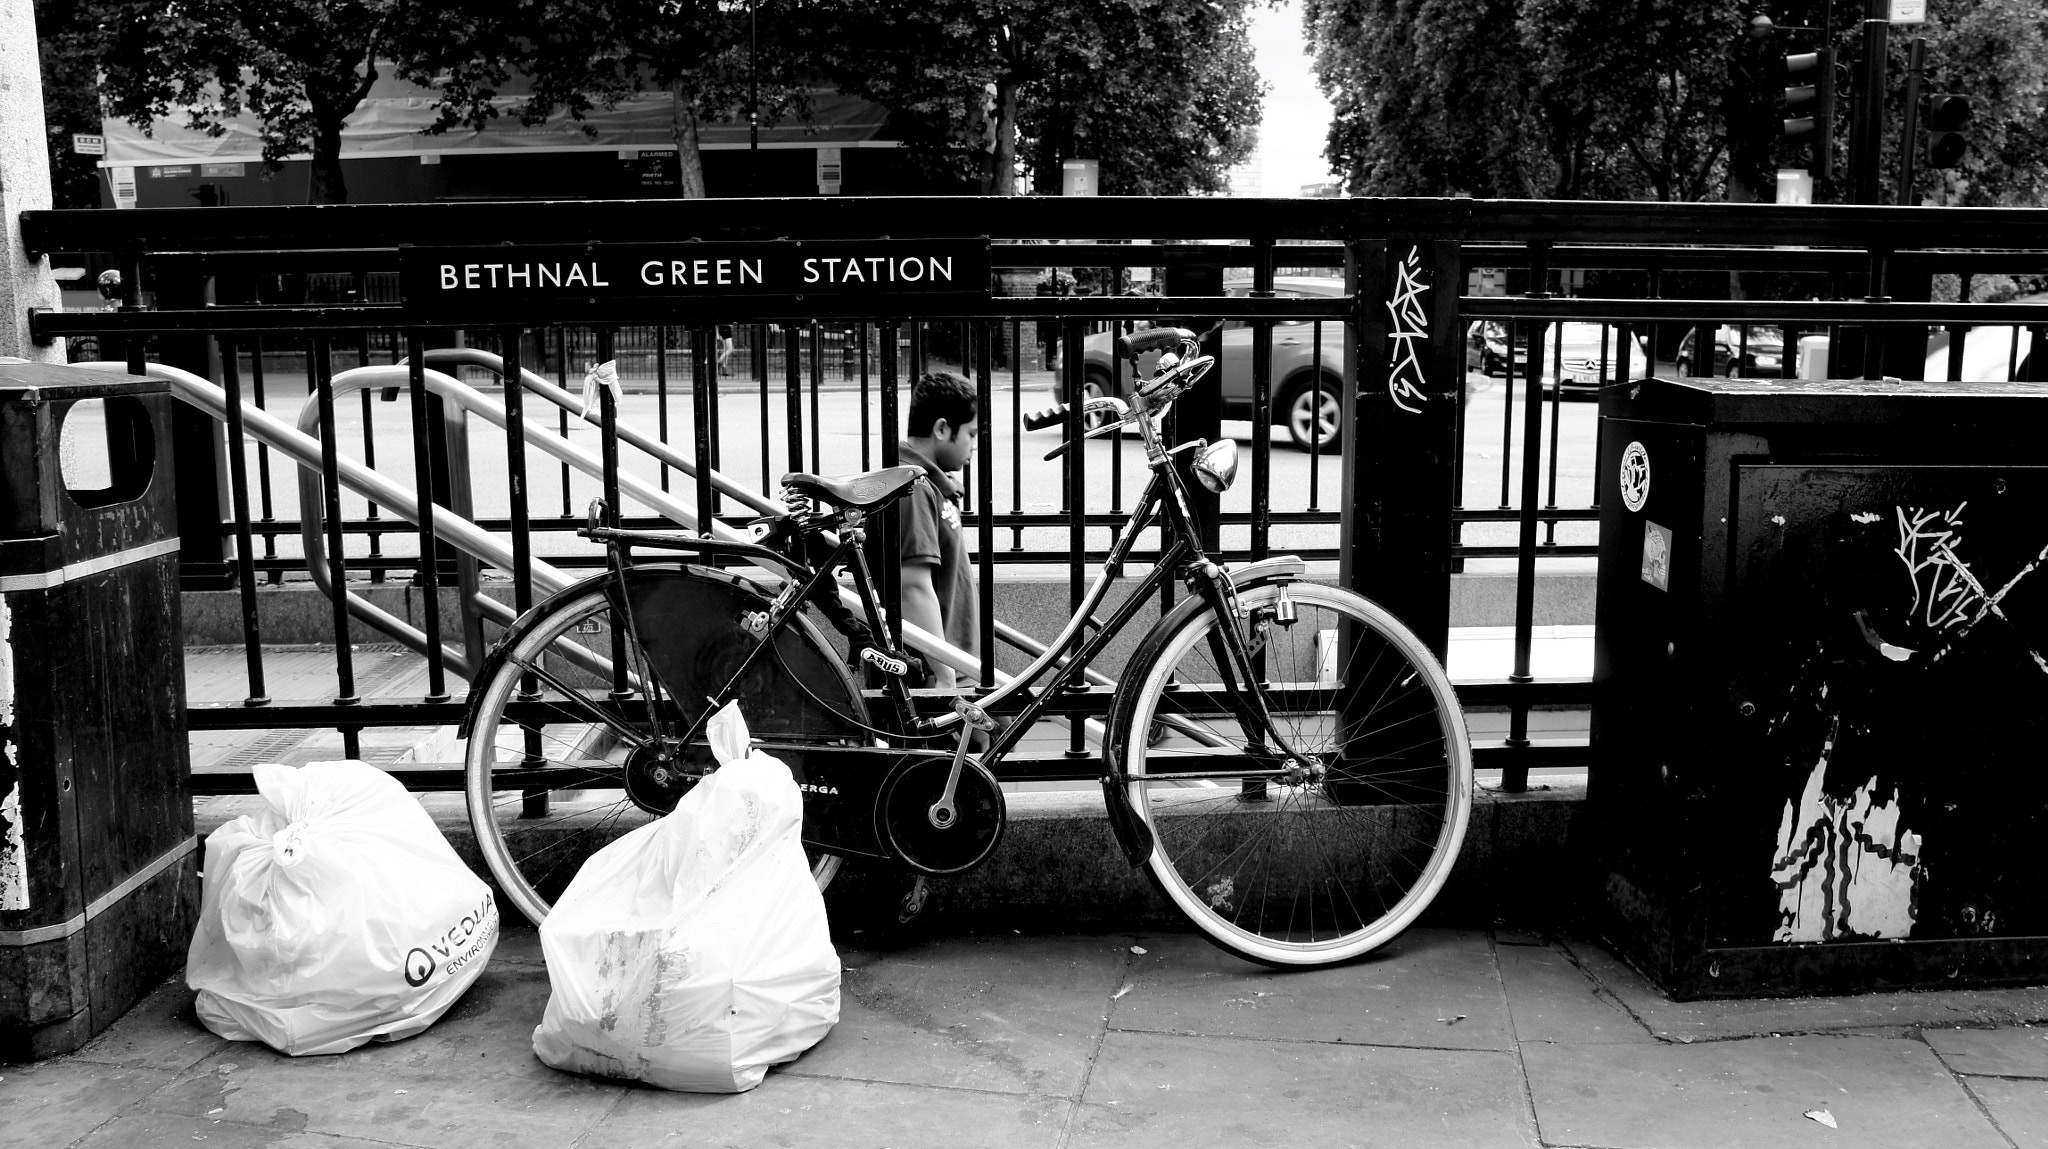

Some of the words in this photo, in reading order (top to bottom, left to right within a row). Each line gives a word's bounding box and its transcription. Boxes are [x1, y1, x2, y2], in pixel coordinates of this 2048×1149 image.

[440, 262, 609, 289] BETHNAL
[641, 259, 762, 285] GREEN
[804, 256, 952, 283] STATION
[866, 653, 900, 673] ABUS
[432, 893, 492, 957] VEOLIA
